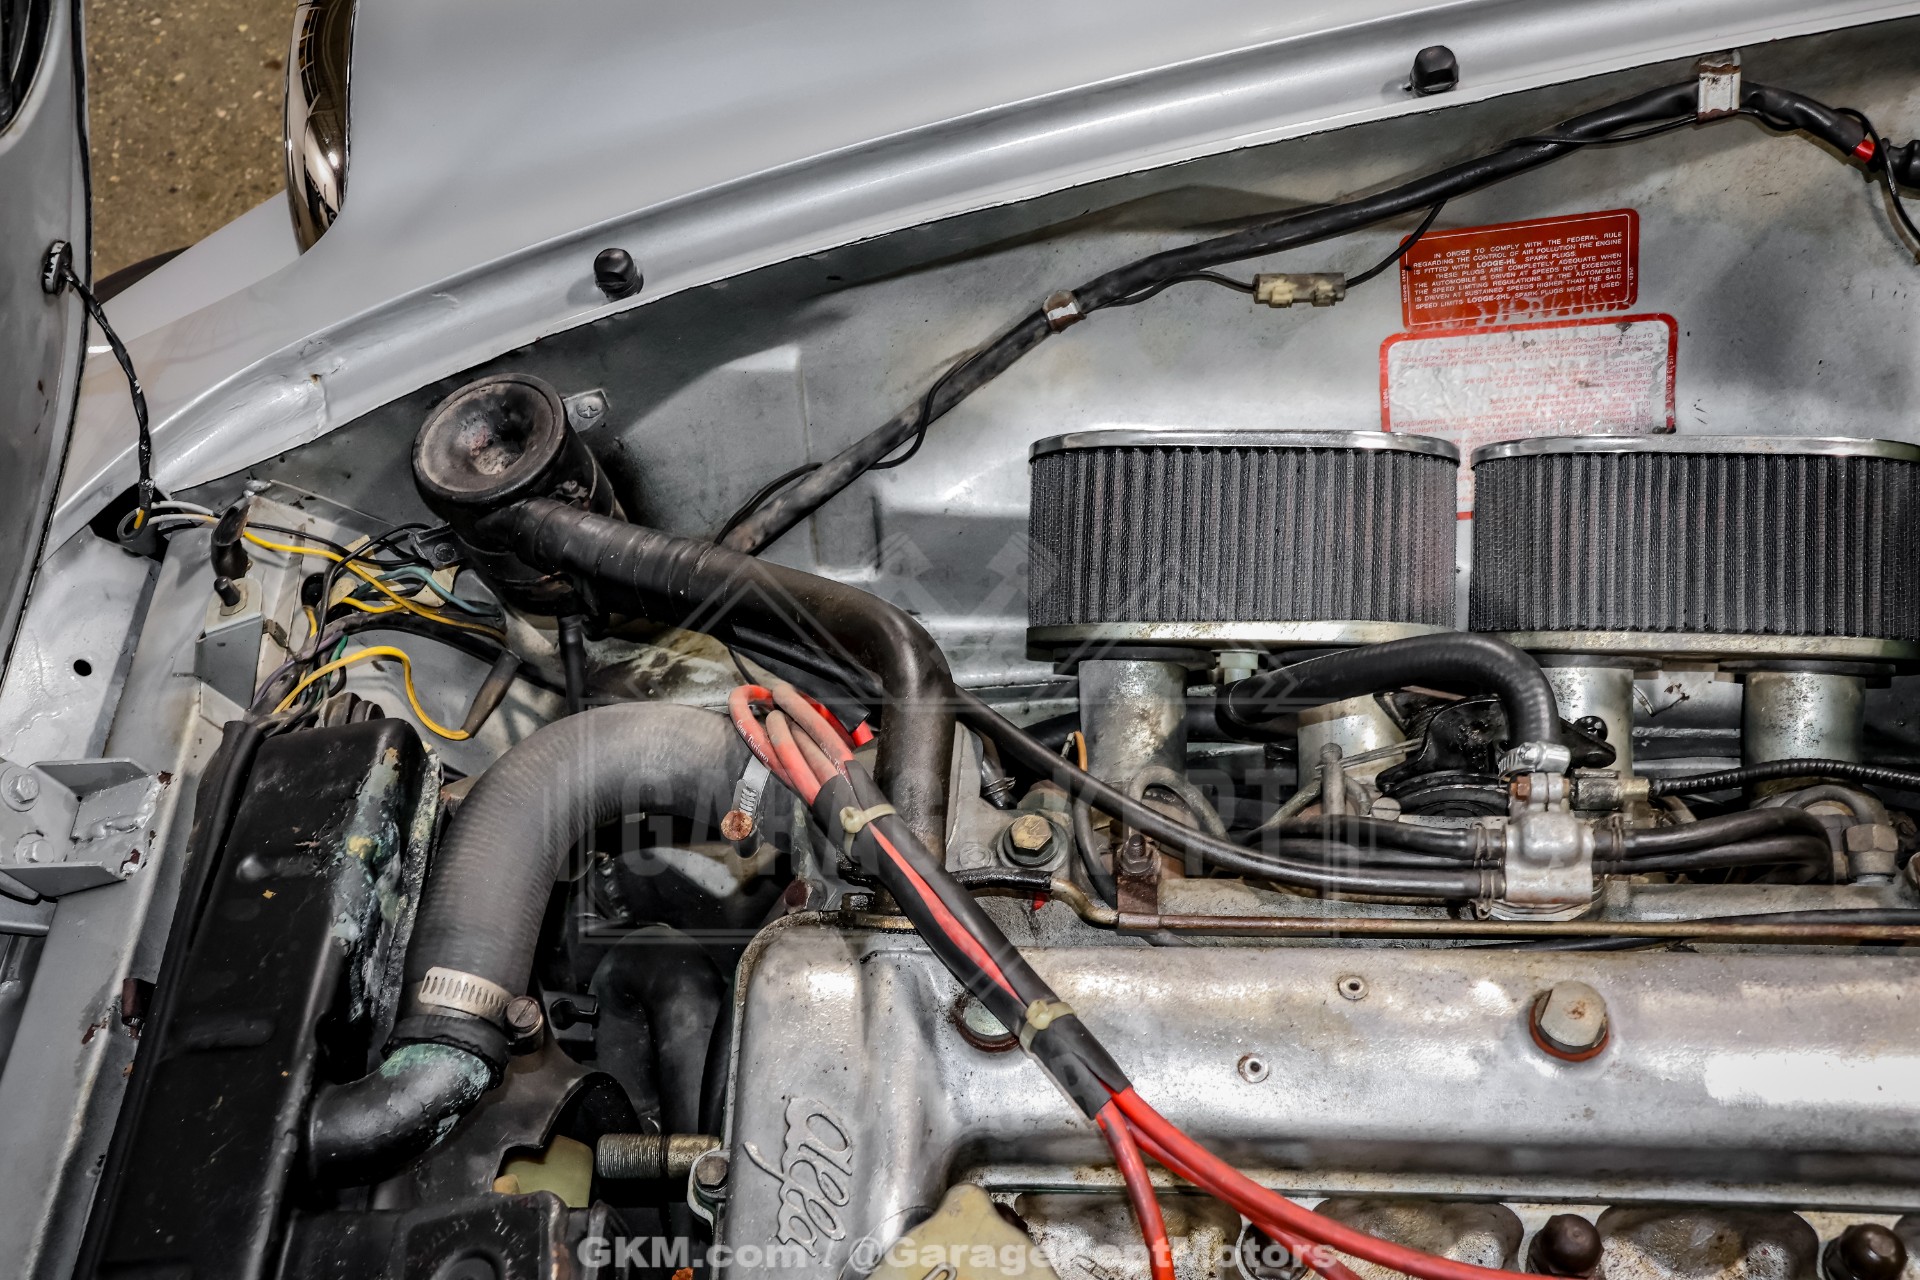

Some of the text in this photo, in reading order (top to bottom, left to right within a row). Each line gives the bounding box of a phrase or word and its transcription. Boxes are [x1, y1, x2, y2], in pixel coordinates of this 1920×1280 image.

[1490, 244, 1519, 252] COMPLY
[1567, 235, 1598, 243] FEDERAL
[1414, 259, 1453, 267] REGARDING
[1473, 253, 1506, 261] CONTROL
[1537, 245, 1575, 253] POLLUTION
[1477, 259, 1516, 268] LODGE-HL
[1508, 261, 1554, 271] COMPLETELY
[1559, 256, 1596, 265] ADEQUATE
[1432, 277, 1476, 285] AUTOMOBILE
[1532, 267, 1559, 275] SPEEDS
[1582, 260, 1621, 269] EXCEEDING
[1459, 282, 1488, 290] LIMITING
[1493, 276, 1541, 286] REGULATIONS
[1576, 267, 1621, 276] AUTOMOBILE
[1465, 288, 1503, 296] SUSTAINED
[1507, 283, 1533, 291] SPEEDS
